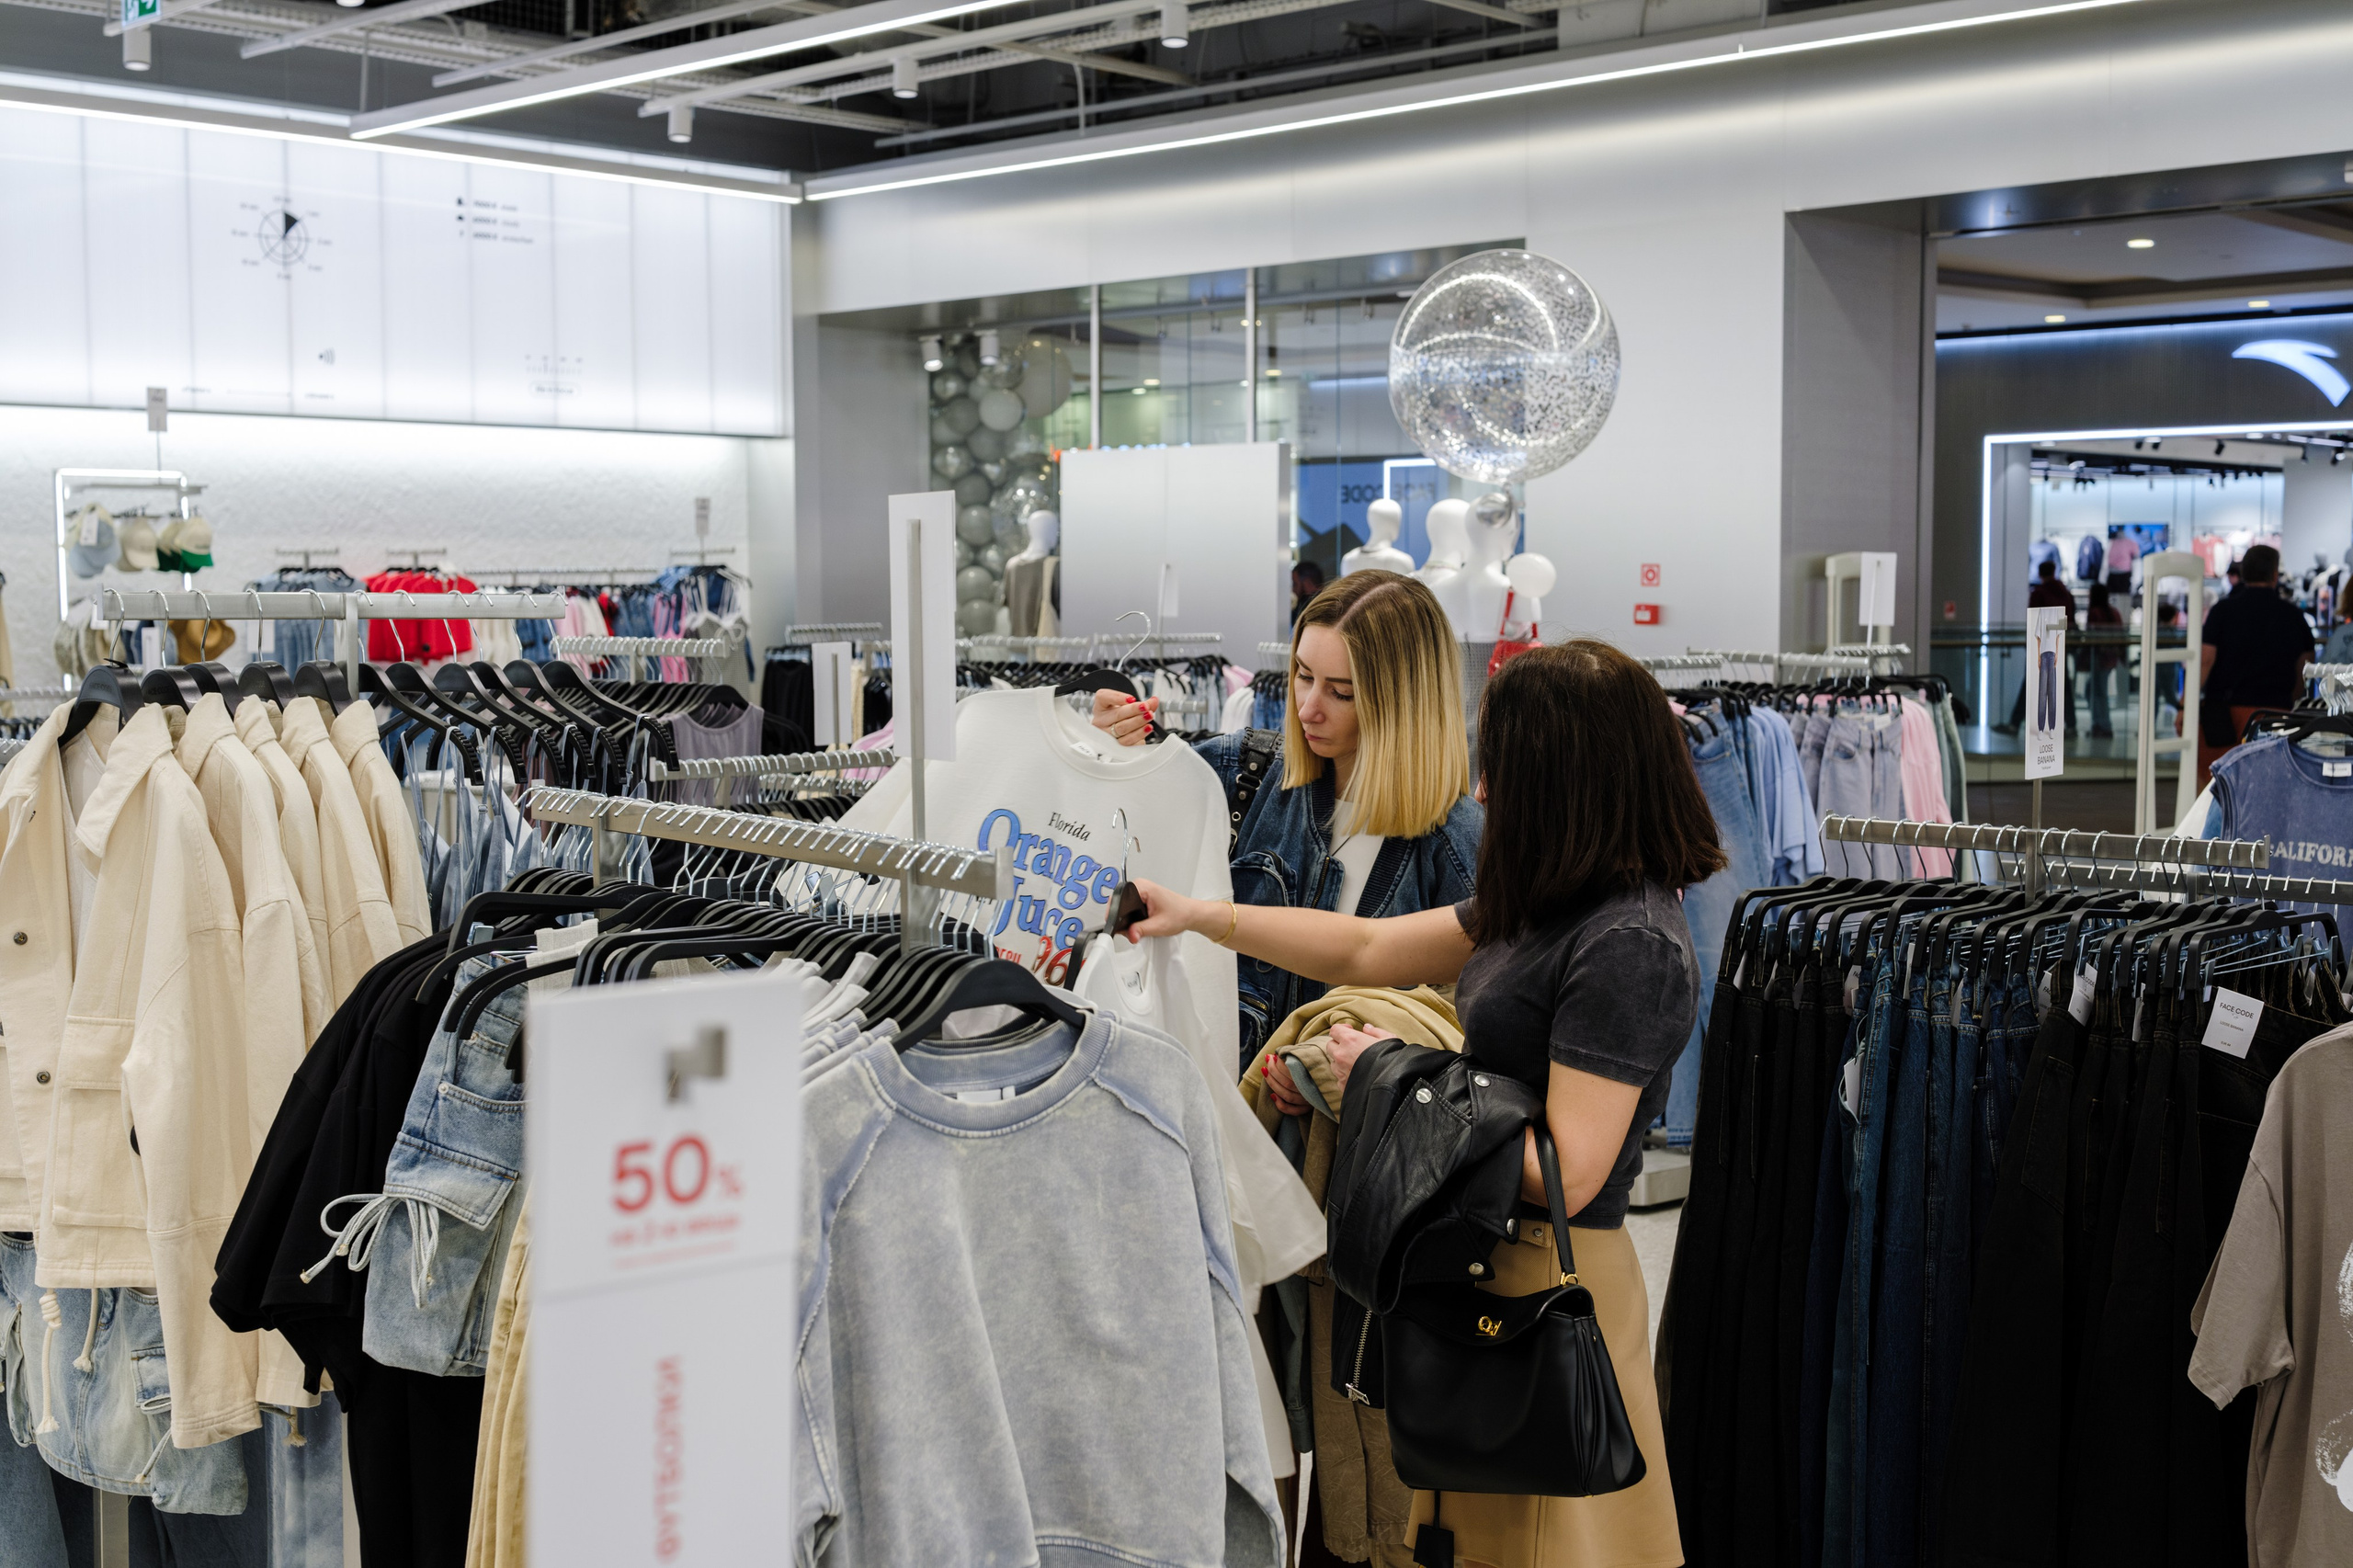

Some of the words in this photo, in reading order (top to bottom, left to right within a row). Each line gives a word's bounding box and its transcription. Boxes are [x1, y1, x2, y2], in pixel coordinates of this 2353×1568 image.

[2037, 755, 2056, 766] BANANA
[2039, 744, 2053, 754] LOOSE
[1047, 812, 1092, 842] Florida
[978, 809, 1119, 909] Orange
[2270, 840, 2353, 869] ALIFOR
[2219, 1002, 2235, 1013] FACE
[2235, 1007, 2255, 1019] CODE
[612, 1134, 744, 1212] 50%
